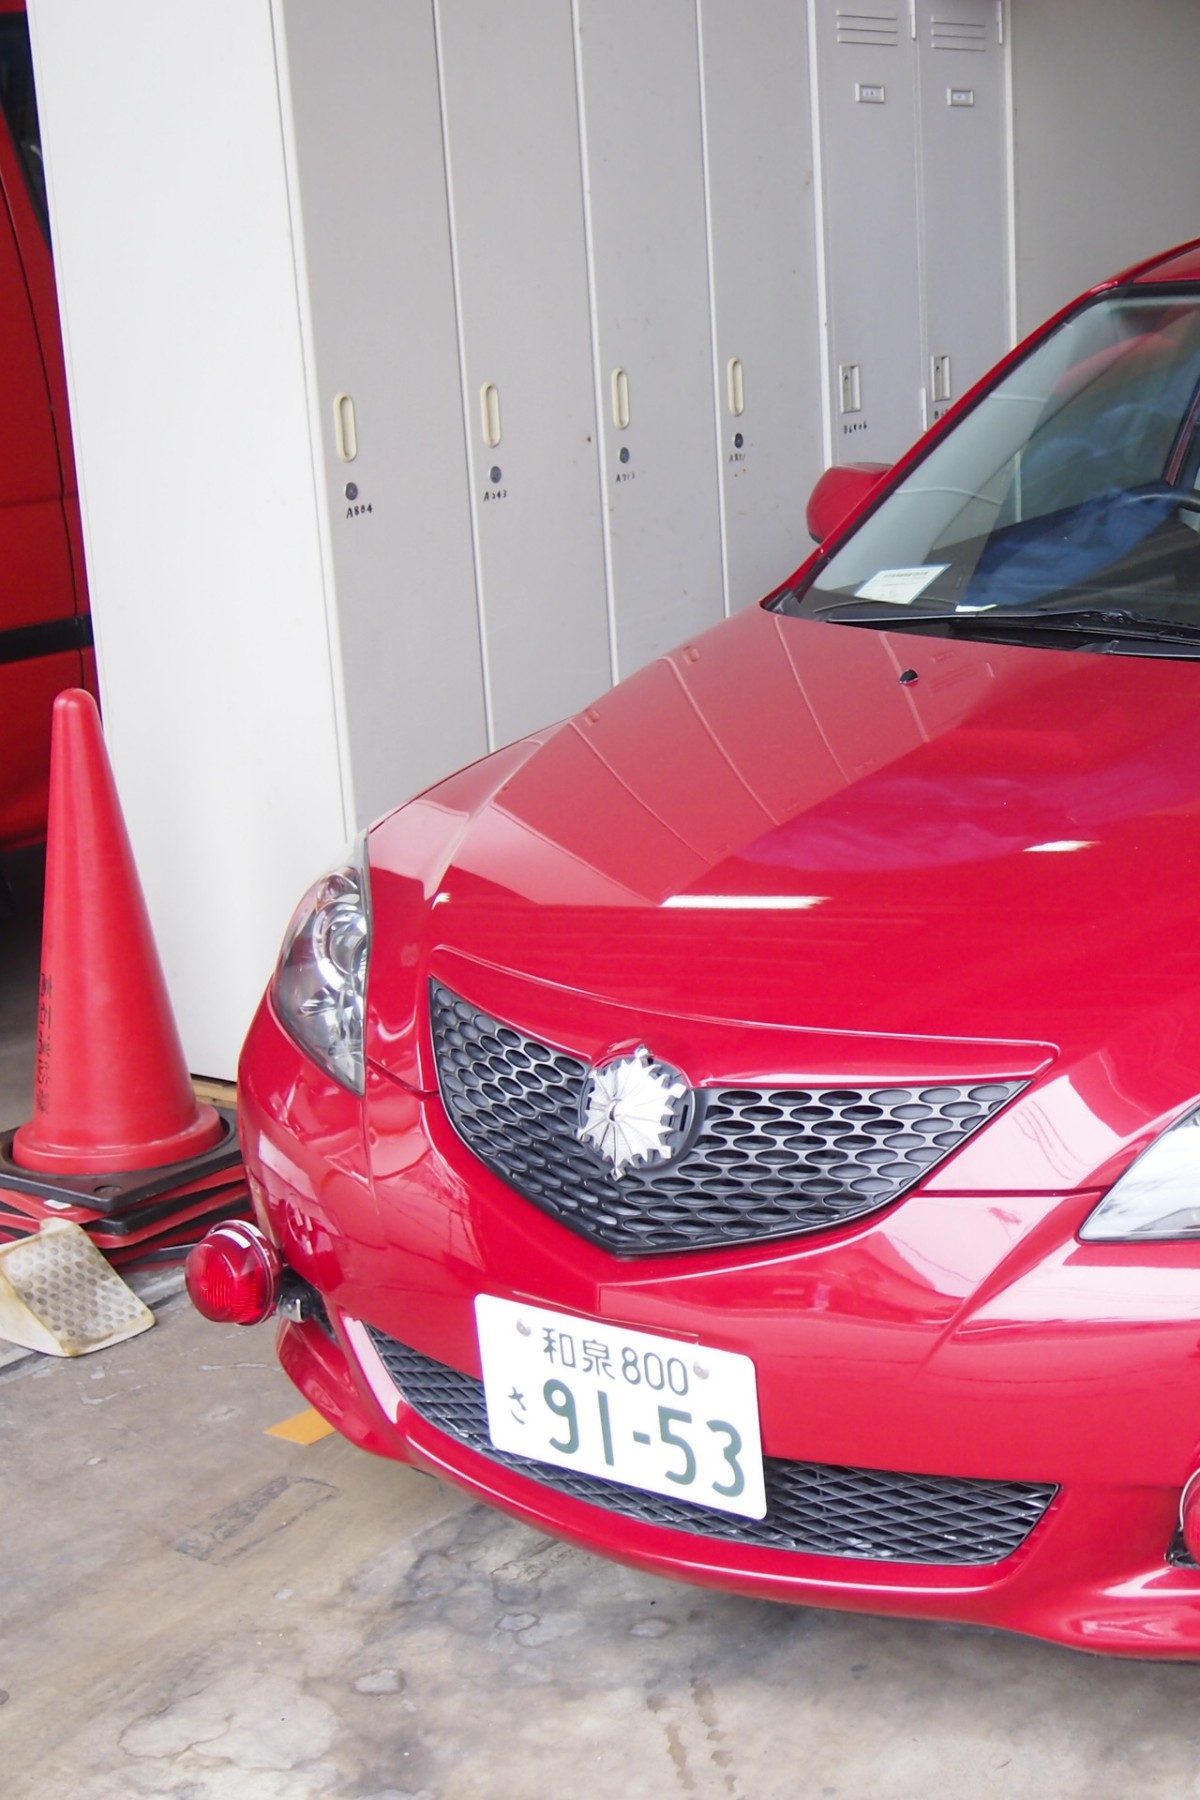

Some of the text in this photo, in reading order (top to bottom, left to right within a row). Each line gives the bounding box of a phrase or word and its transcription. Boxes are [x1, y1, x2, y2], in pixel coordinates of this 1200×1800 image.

[541, 1326, 690, 1397] 和泉800
[507, 1377, 746, 1499] さ 91-53
